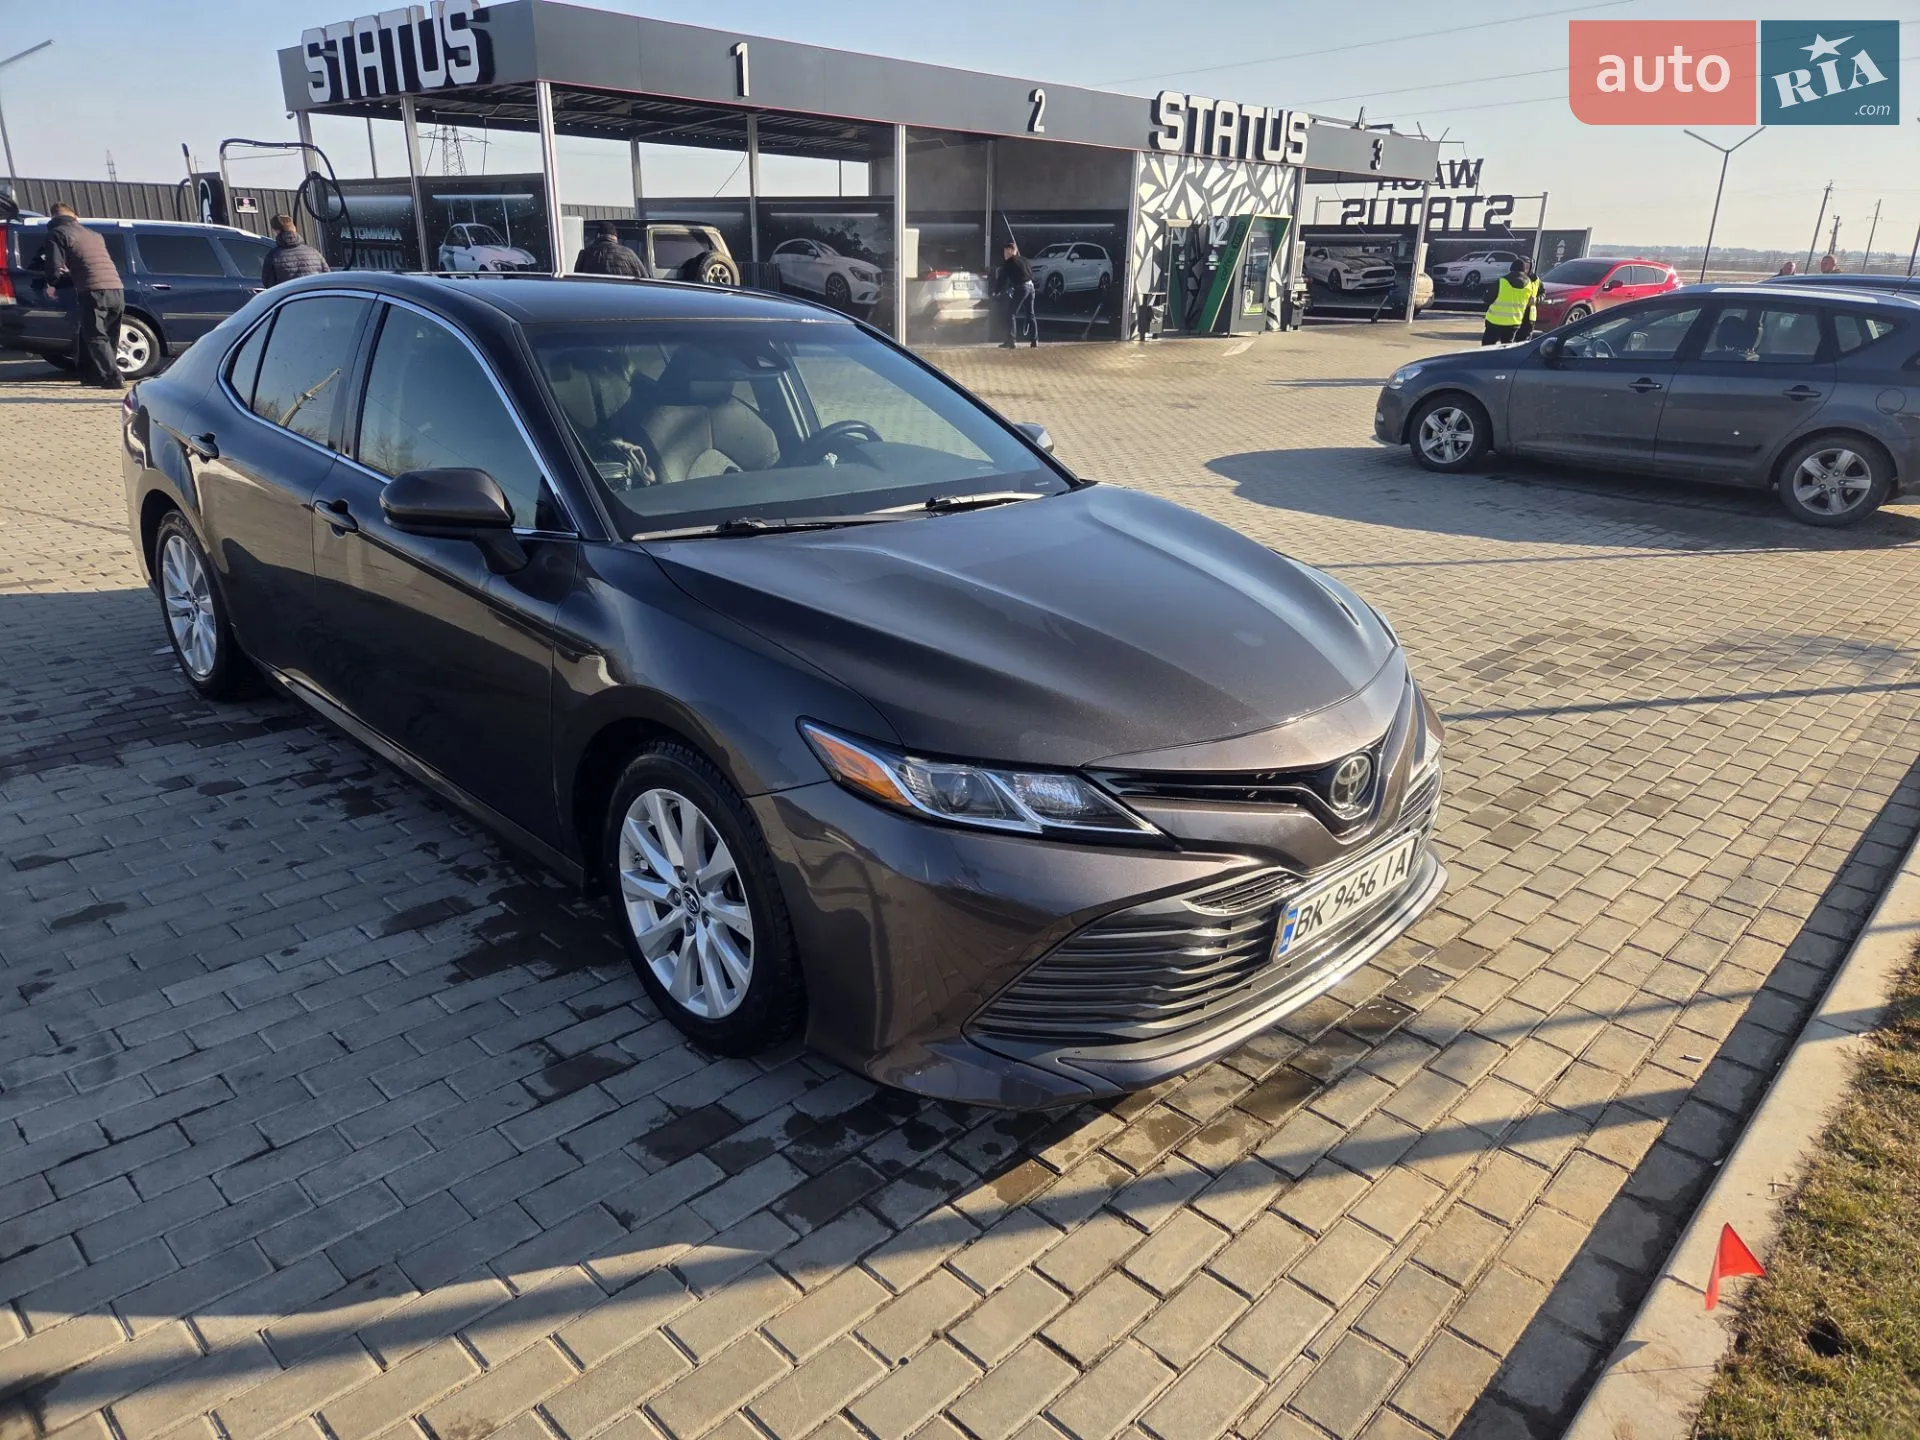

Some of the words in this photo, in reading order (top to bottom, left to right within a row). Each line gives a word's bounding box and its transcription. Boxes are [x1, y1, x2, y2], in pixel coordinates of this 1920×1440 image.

[301, 0, 480, 103] STATUS
[733, 42, 750, 97] 1
[1031, 89, 1046, 132] 2
[1153, 90, 1311, 164] STATUS
[1372, 138, 1384, 170] 3
[1293, 893, 1331, 941] BK
[1329, 864, 1380, 920] 9456
[1383, 847, 1407, 887] IA
